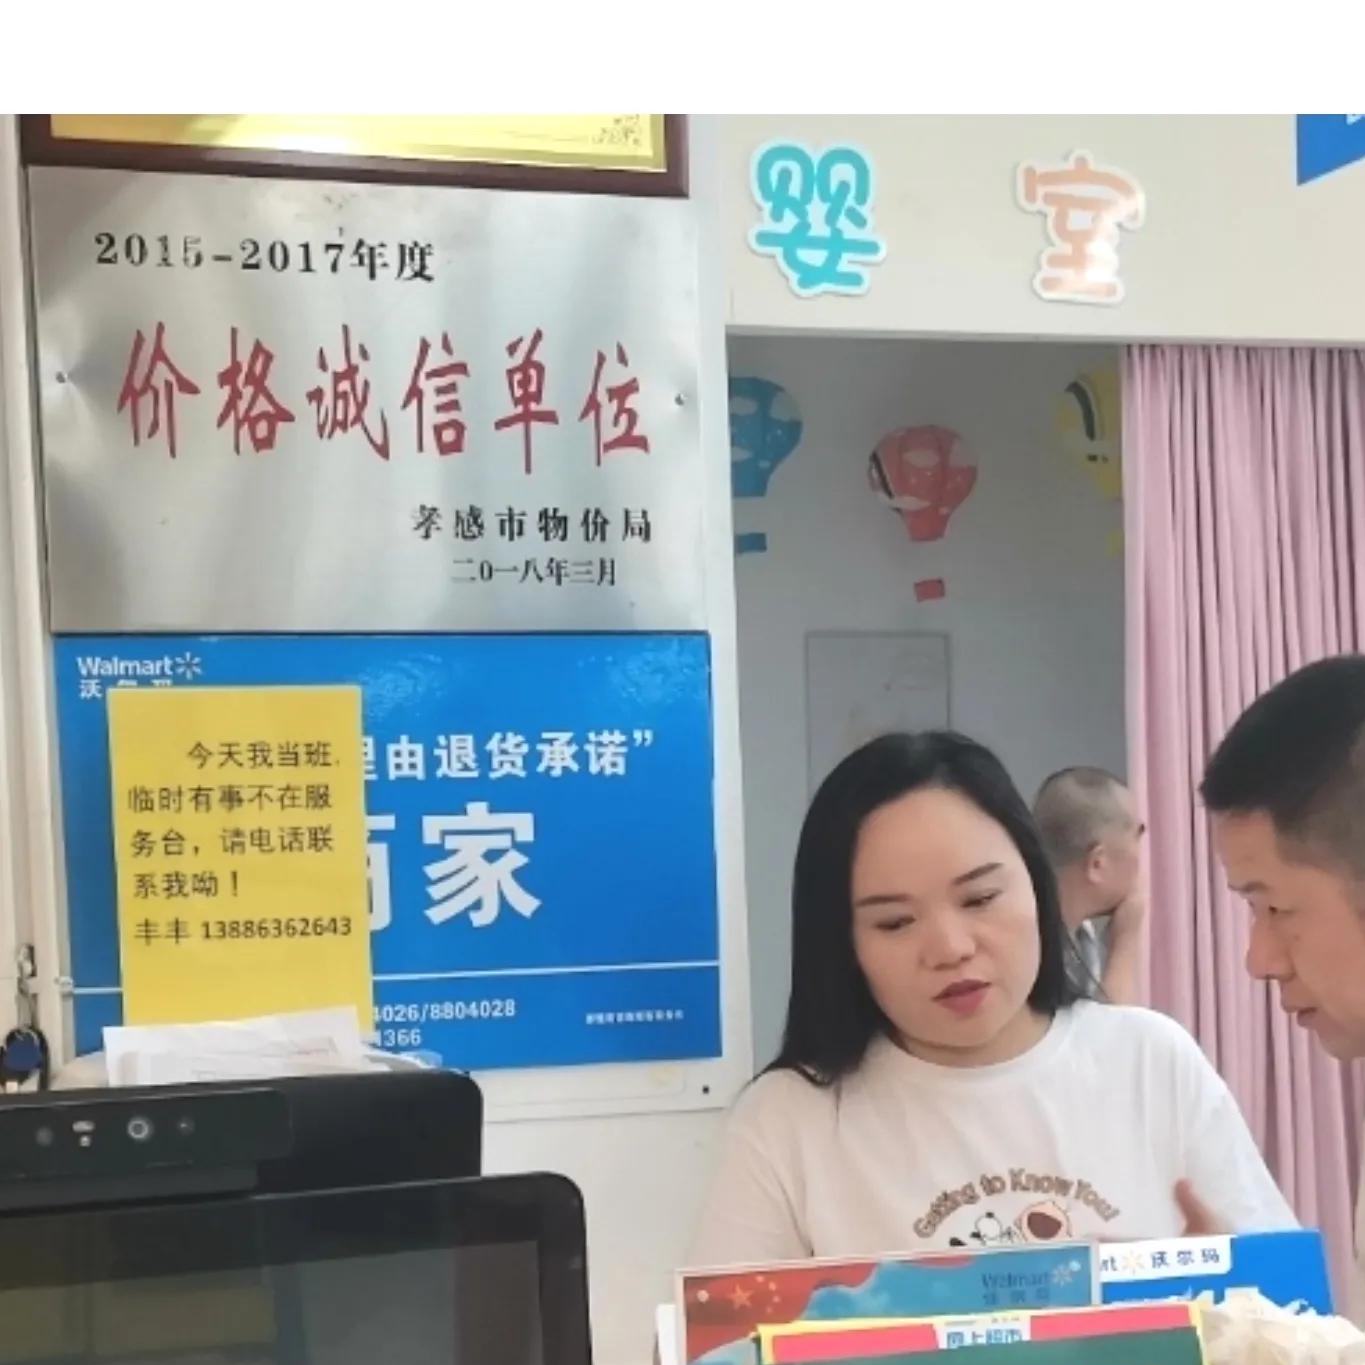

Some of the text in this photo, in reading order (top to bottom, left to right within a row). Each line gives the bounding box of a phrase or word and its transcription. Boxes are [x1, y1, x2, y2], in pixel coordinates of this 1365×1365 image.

[752, 145, 1144, 297] 婴 室
[95, 232, 435, 282] 2015-2017年度
[117, 321, 650, 473] 价格诚信单位
[413, 504, 651, 542] 孝感市物价局
[76, 655, 173, 676] Walmart
[128, 785, 332, 812] 临时有事不在服
[132, 825, 333, 857] 务台，请电话联
[134, 917, 351, 944] 丰丰 13886362643
[980, 1173, 1006, 1197] to
[1009, 1167, 1074, 1197] Know
